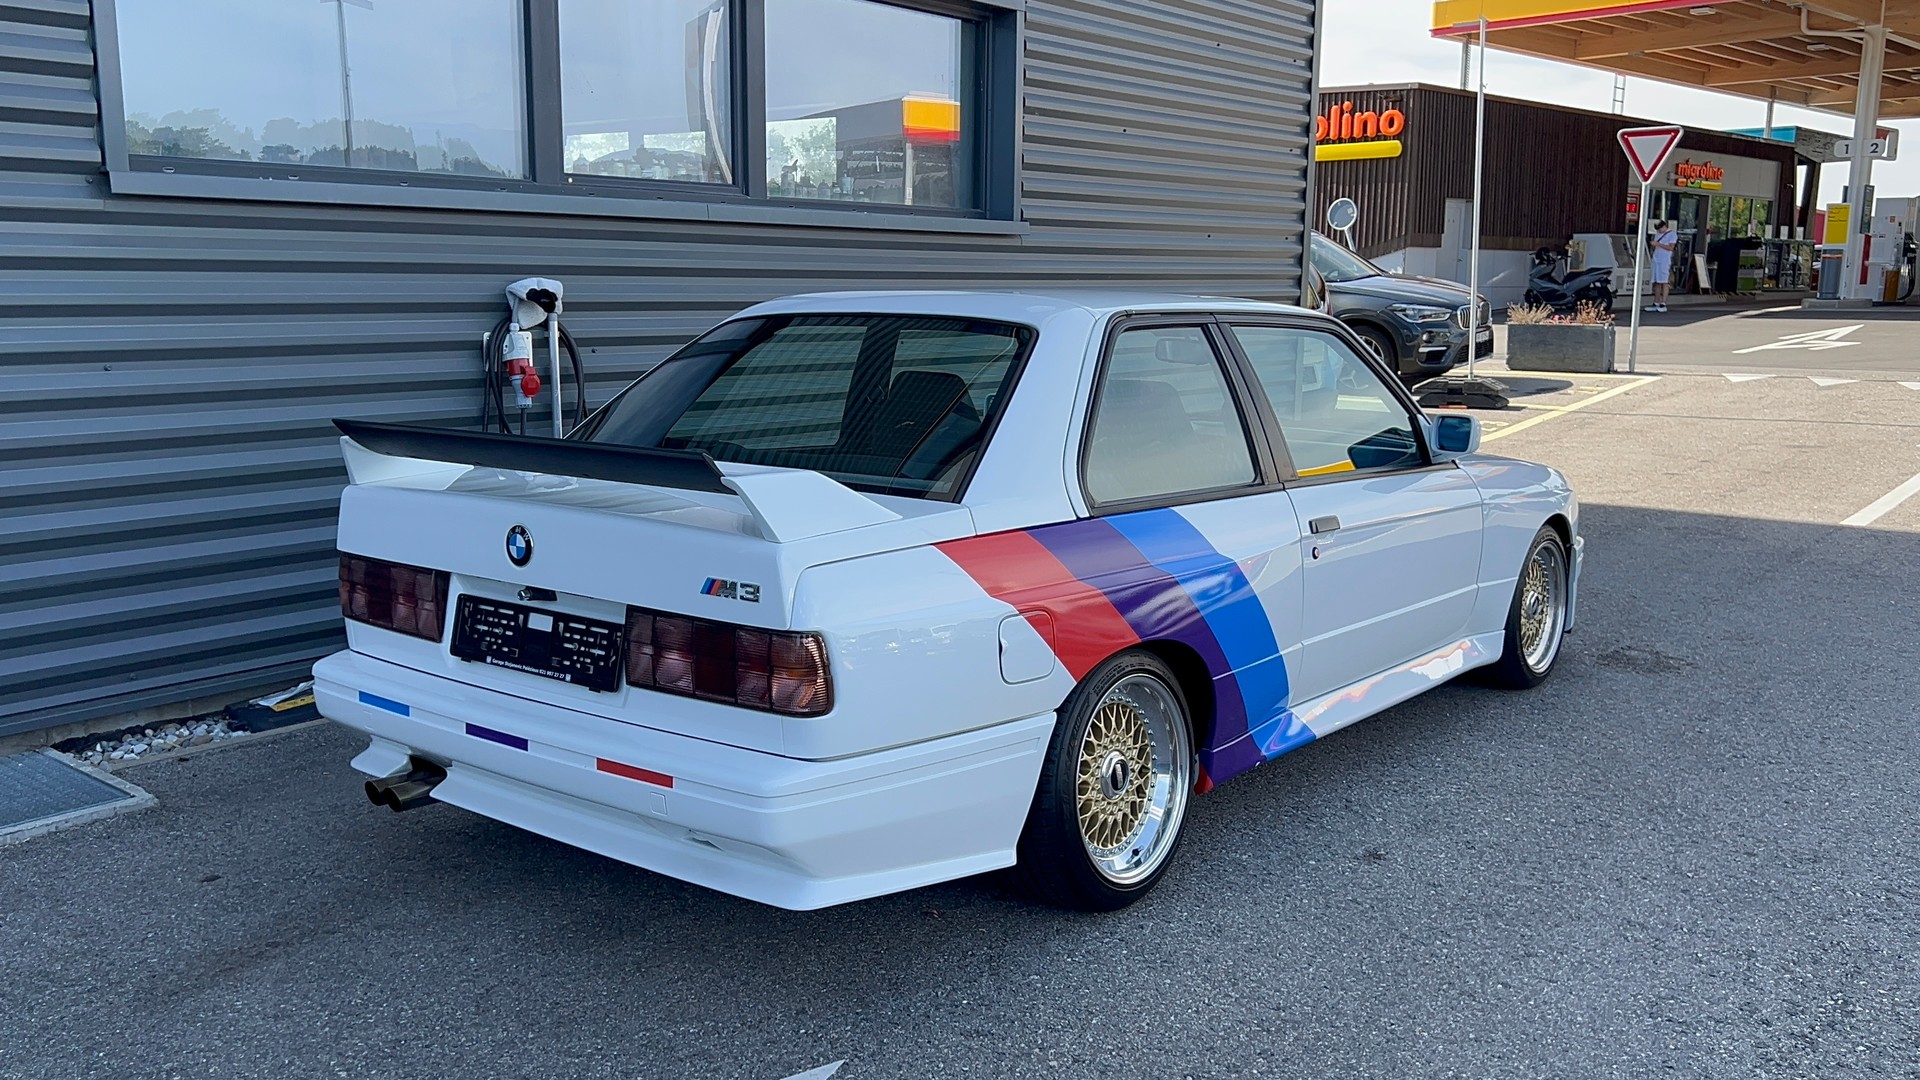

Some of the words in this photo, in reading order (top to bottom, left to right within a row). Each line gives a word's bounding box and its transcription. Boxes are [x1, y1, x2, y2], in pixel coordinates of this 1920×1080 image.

[1844, 143, 1850, 155] 1
[1870, 143, 1879, 154] 2
[1677, 158, 1725, 181] migrolino
[508, 526, 531, 541] BMW
[716, 579, 760, 603] M3
